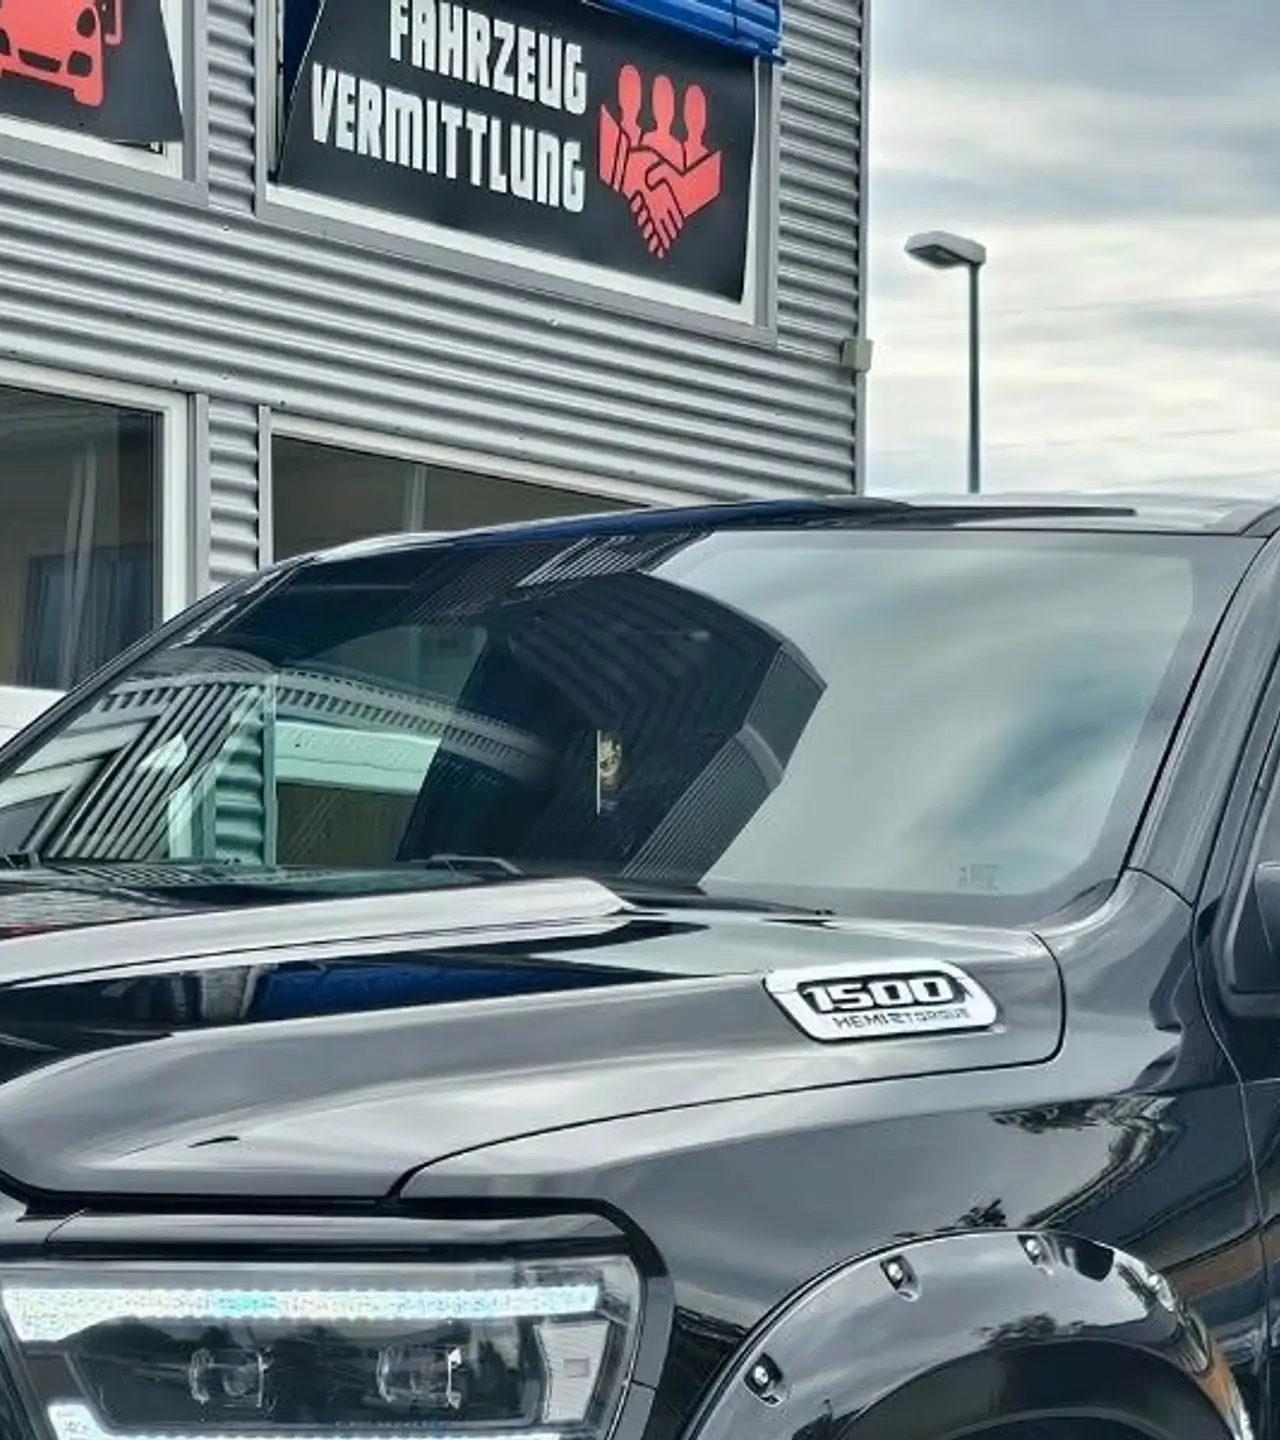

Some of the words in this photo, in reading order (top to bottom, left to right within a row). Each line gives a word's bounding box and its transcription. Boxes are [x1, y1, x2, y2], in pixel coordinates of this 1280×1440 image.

[389, 0, 588, 115] FAHRZEUG
[311, 61, 586, 213] VERMITTLUNG
[803, 976, 955, 1012] 1500
